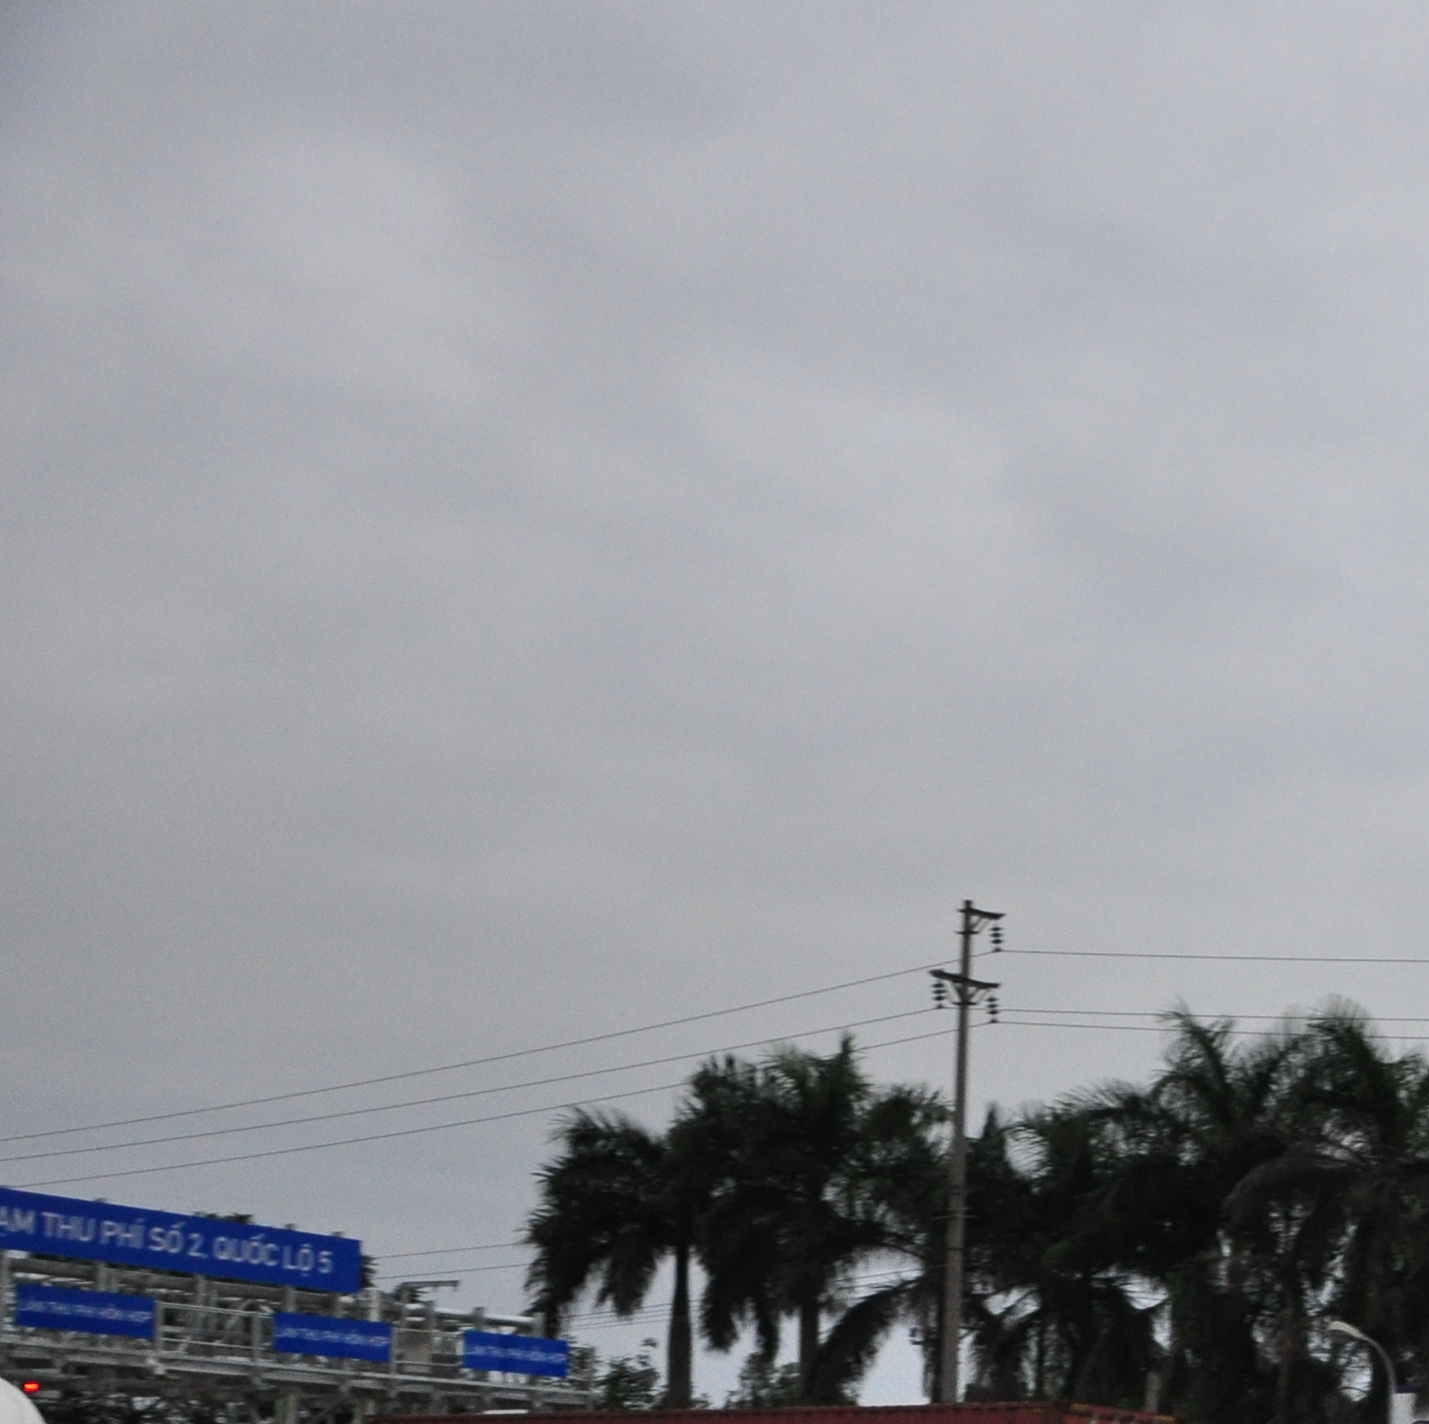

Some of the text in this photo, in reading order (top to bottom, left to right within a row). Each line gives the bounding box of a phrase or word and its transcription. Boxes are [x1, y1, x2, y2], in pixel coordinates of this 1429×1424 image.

[42, 1211, 96, 1242] THU
[101, 1218, 145, 1249] PHÍ
[149, 1222, 186, 1253] SỐ
[212, 1233, 280, 1267] QUỐC
[282, 1243, 315, 1277] LỘ
[317, 1250, 333, 1274] 5
